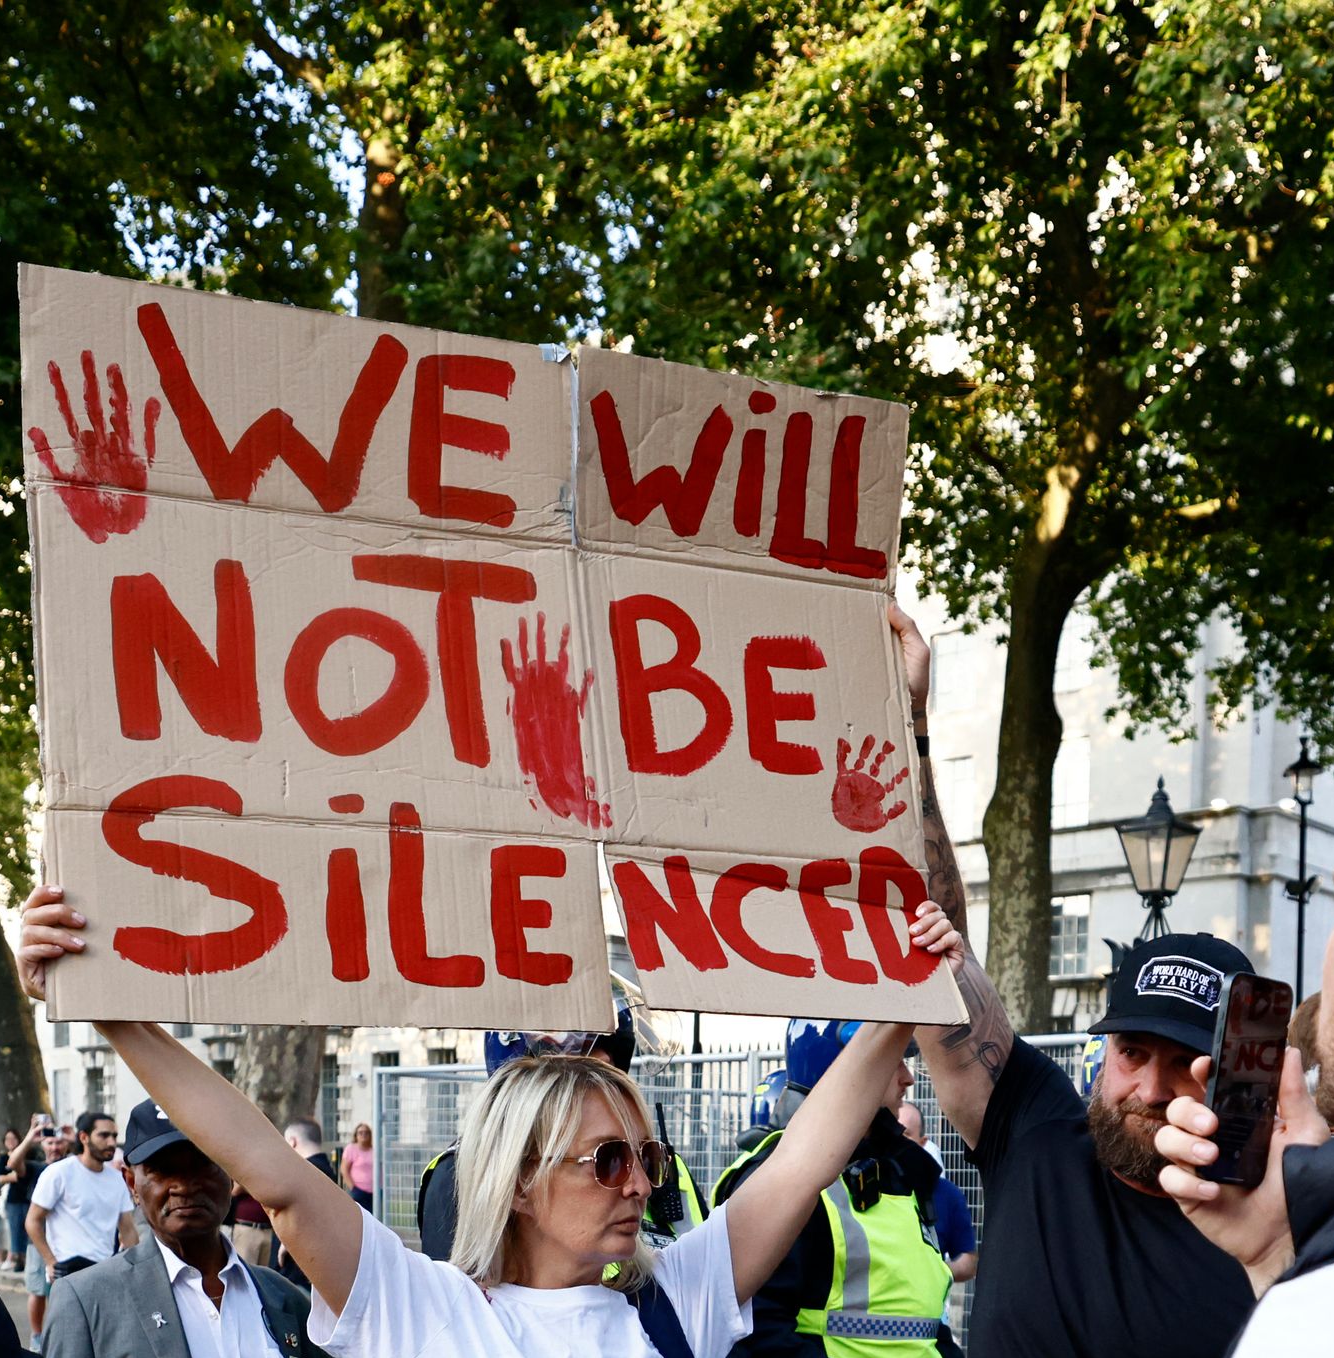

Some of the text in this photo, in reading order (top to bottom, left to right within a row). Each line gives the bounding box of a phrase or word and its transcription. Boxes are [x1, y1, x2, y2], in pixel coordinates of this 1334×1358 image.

[136, 301, 517, 528] WE
[109, 553, 827, 778] NOT BE
[1150, 975, 1207, 995] STARVE
[1152, 965, 1210, 986] WORK HARD OR
